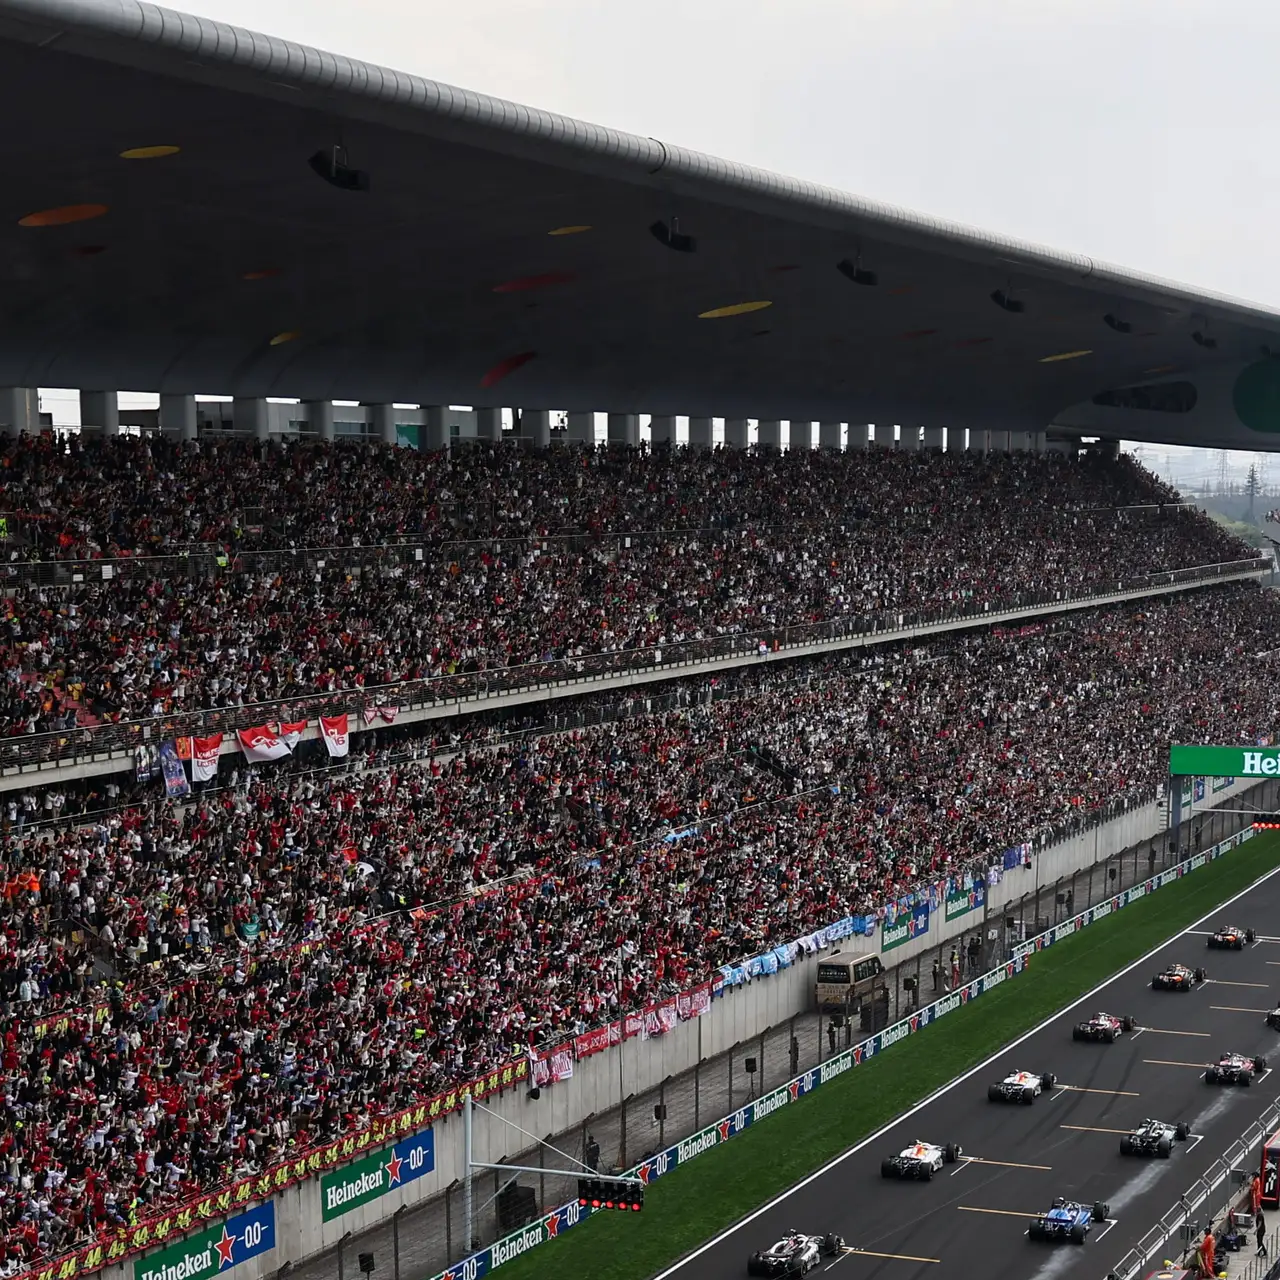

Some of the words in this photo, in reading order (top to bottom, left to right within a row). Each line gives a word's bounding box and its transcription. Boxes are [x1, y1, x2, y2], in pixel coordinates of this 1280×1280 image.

[820, 1055, 851, 1084] Heineken
[753, 1089, 788, 1121] Heineken
[678, 1129, 716, 1164] Heineken
[236, 1182, 251, 1202] 44
[327, 1166, 382, 1210] Heineken
[133, 1226, 149, 1247] 44
[155, 1218, 170, 1238] 44
[84, 1246, 103, 1269] 44
[491, 1224, 542, 1268] Heineken
[59, 1256, 77, 1279] 44
